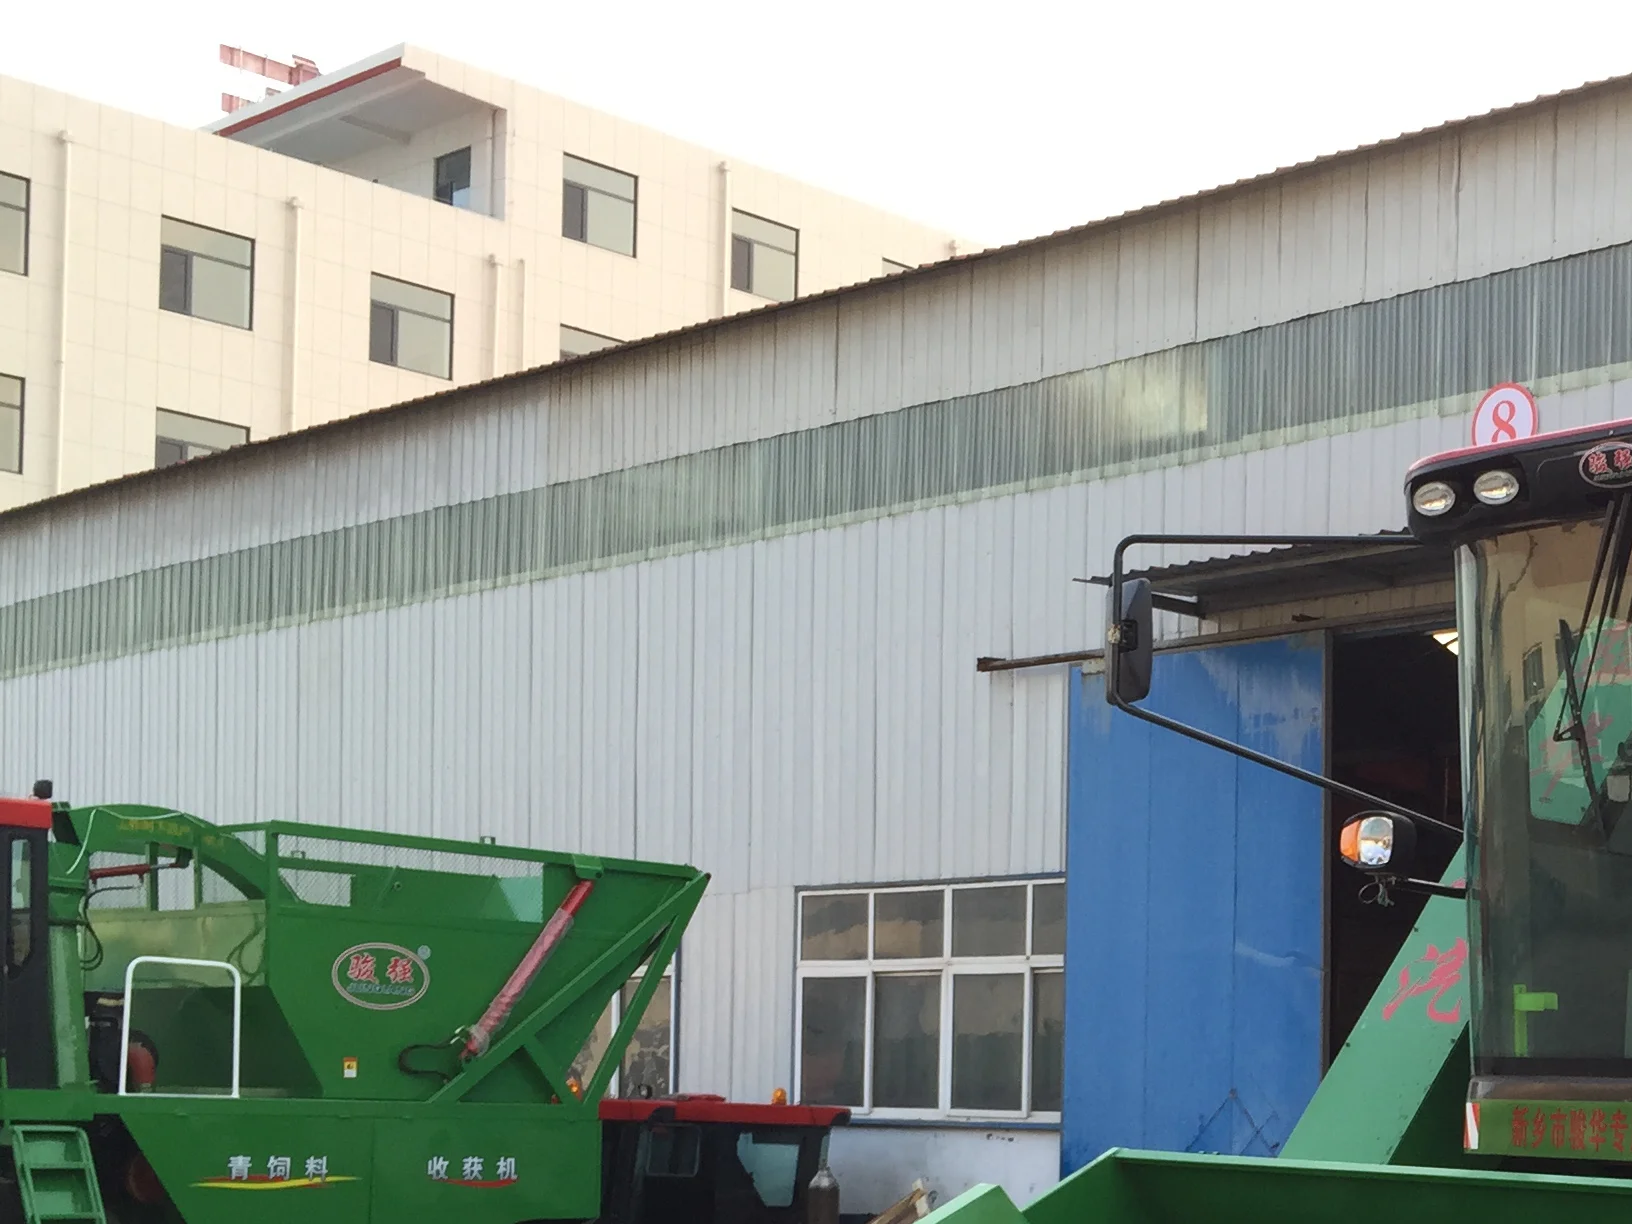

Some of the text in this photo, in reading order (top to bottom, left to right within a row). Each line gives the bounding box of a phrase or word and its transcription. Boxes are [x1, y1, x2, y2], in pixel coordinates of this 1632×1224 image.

[1491, 400, 1517, 443] 8
[346, 952, 414, 984] 骏强
[227, 1154, 518, 1182] 青饲料 收获机
